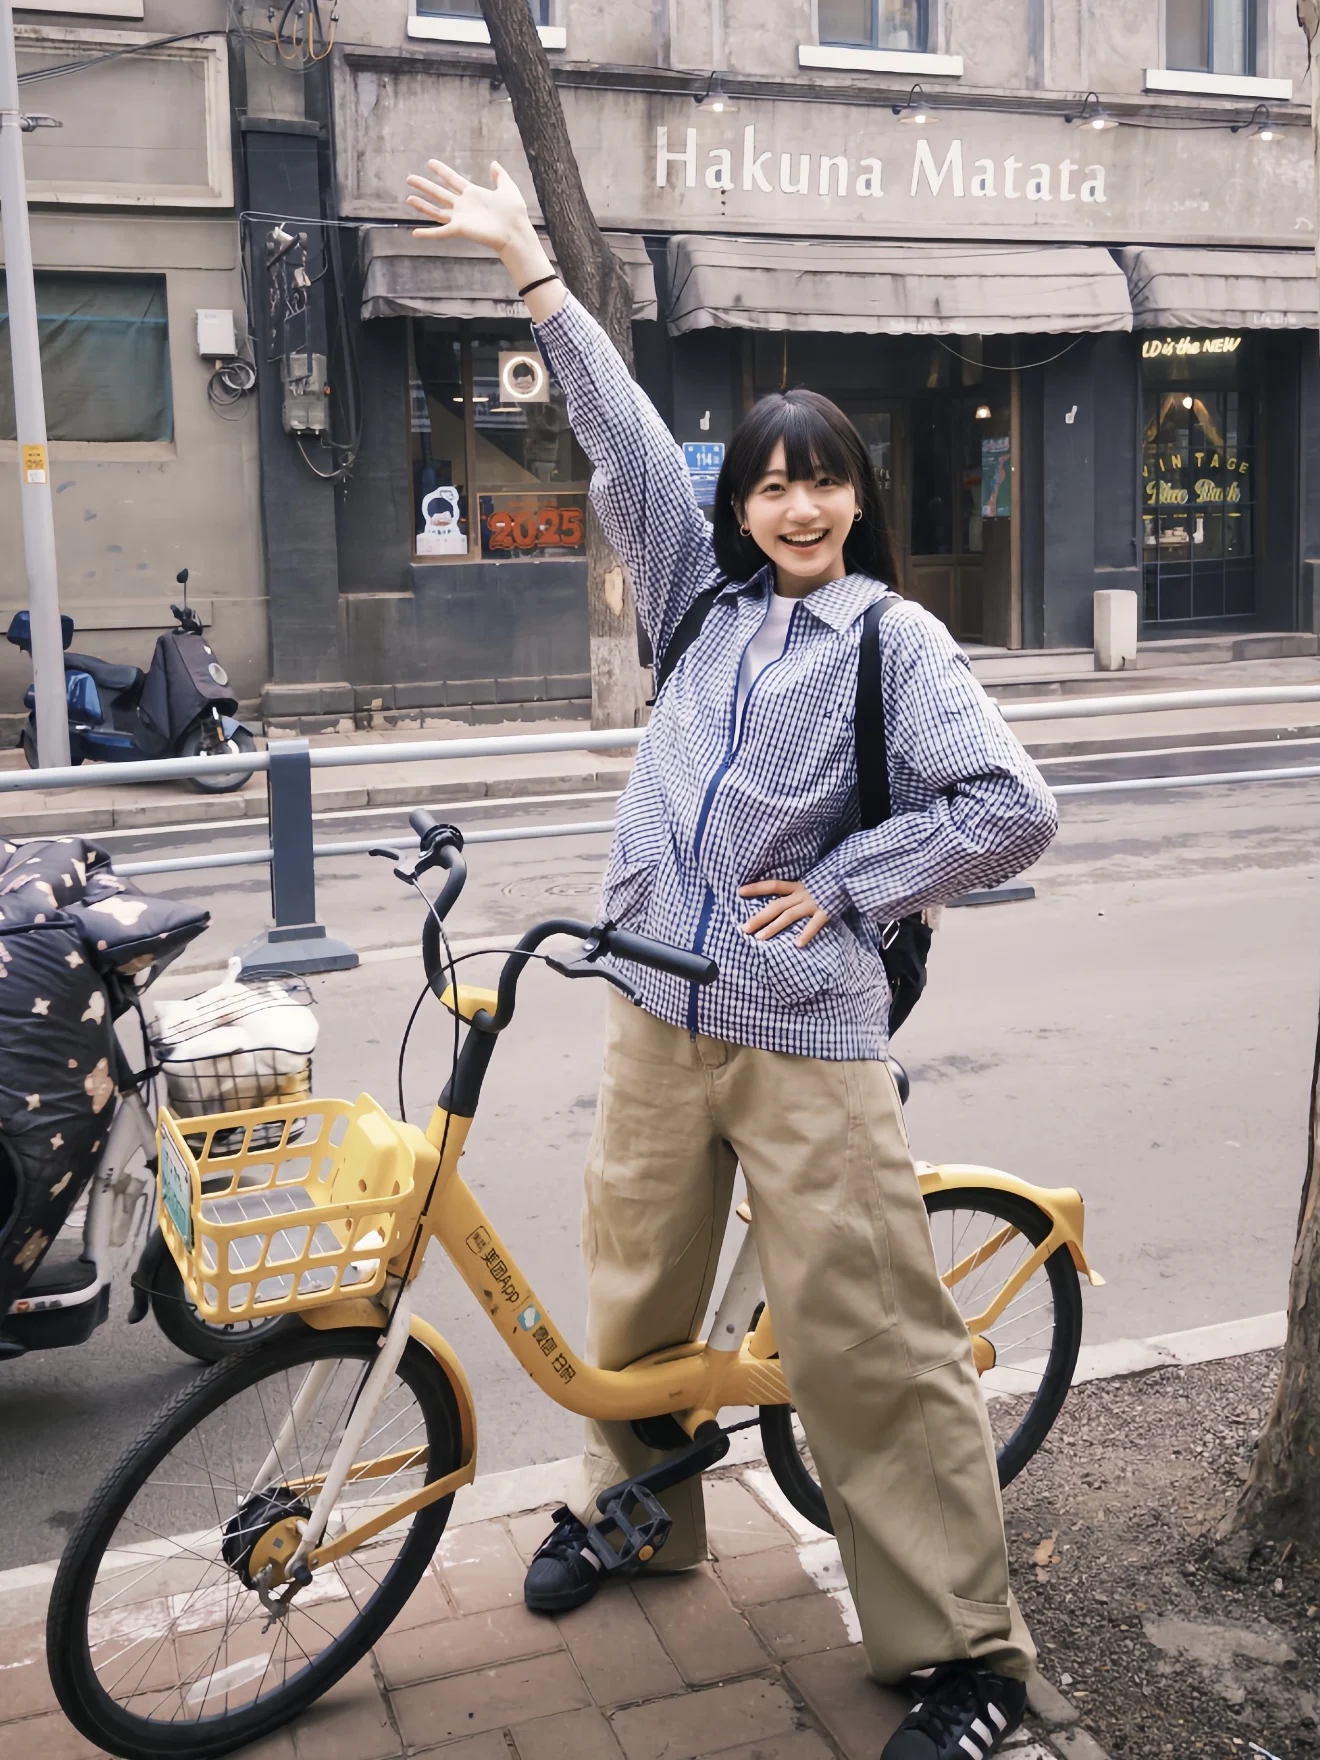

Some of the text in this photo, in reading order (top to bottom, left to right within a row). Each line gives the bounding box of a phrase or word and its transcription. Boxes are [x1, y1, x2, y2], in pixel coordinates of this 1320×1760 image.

[656, 124, 1107, 203] Hakuna Matata
[1161, 337, 1175, 356] is
[1175, 336, 1201, 355] the
[1202, 336, 1242, 353] NEW
[696, 452, 712, 466] 114
[1142, 452, 1249, 477] VINTAGE
[488, 508, 583, 550] 2025
